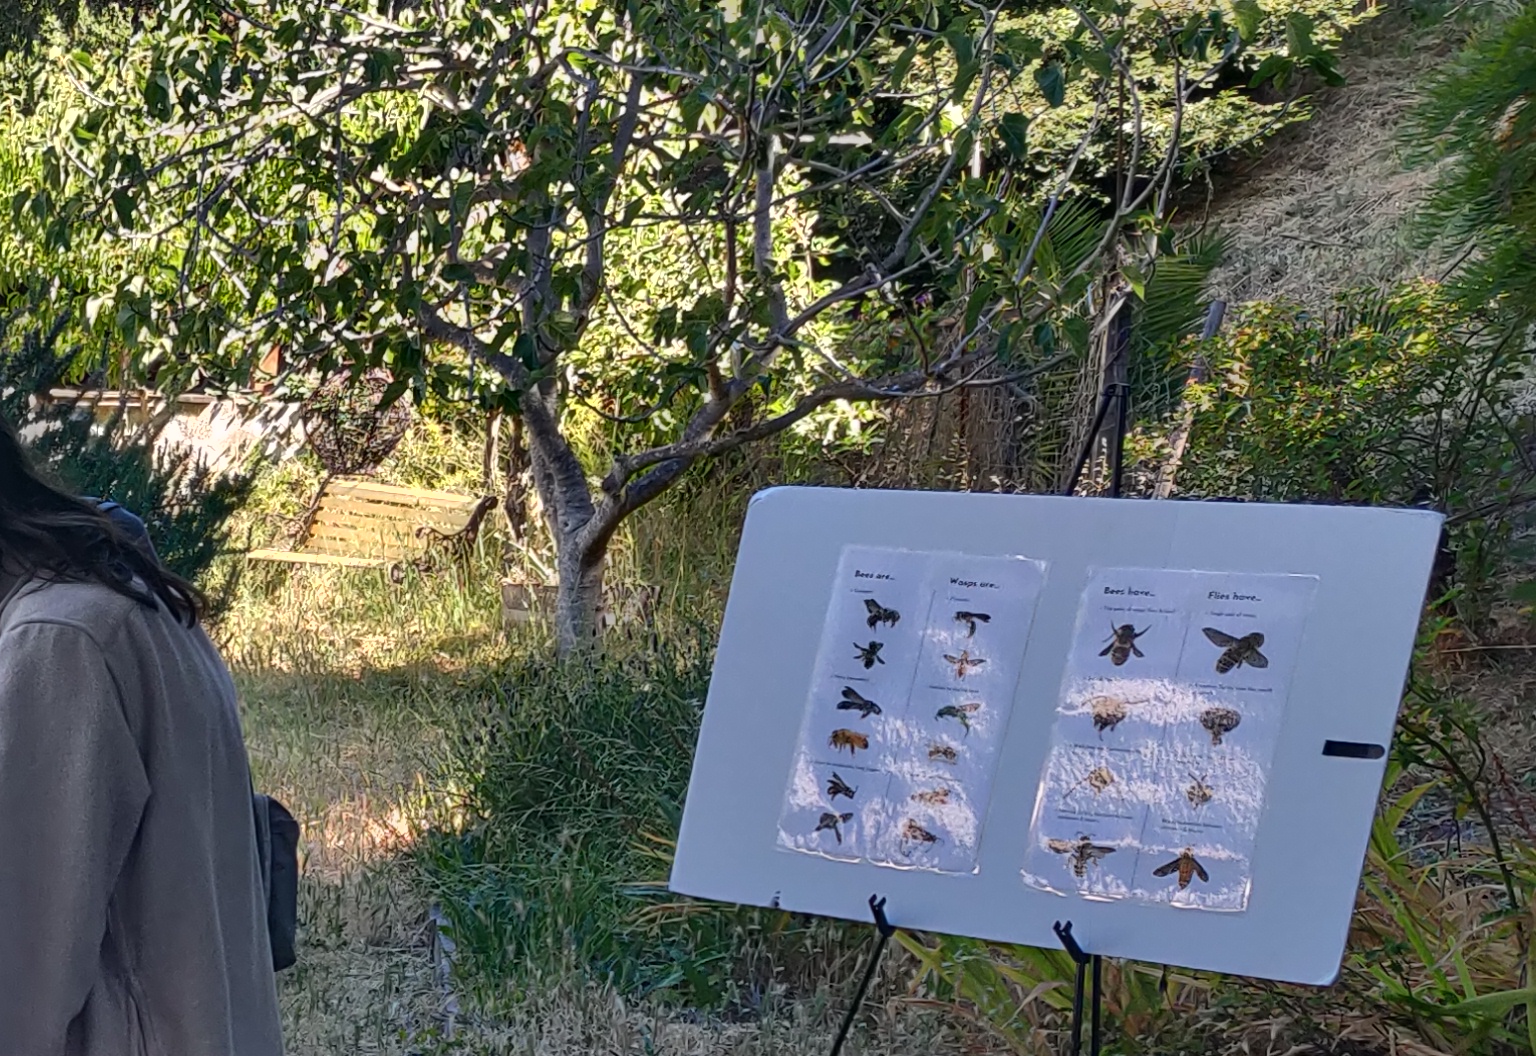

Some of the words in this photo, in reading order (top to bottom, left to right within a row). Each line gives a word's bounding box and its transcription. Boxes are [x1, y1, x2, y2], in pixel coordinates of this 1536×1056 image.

[854, 569, 874, 579] Bees
[949, 576, 978, 588] Wasps
[1103, 586, 1126, 595] Bees
[1207, 590, 1230, 600] Flies
